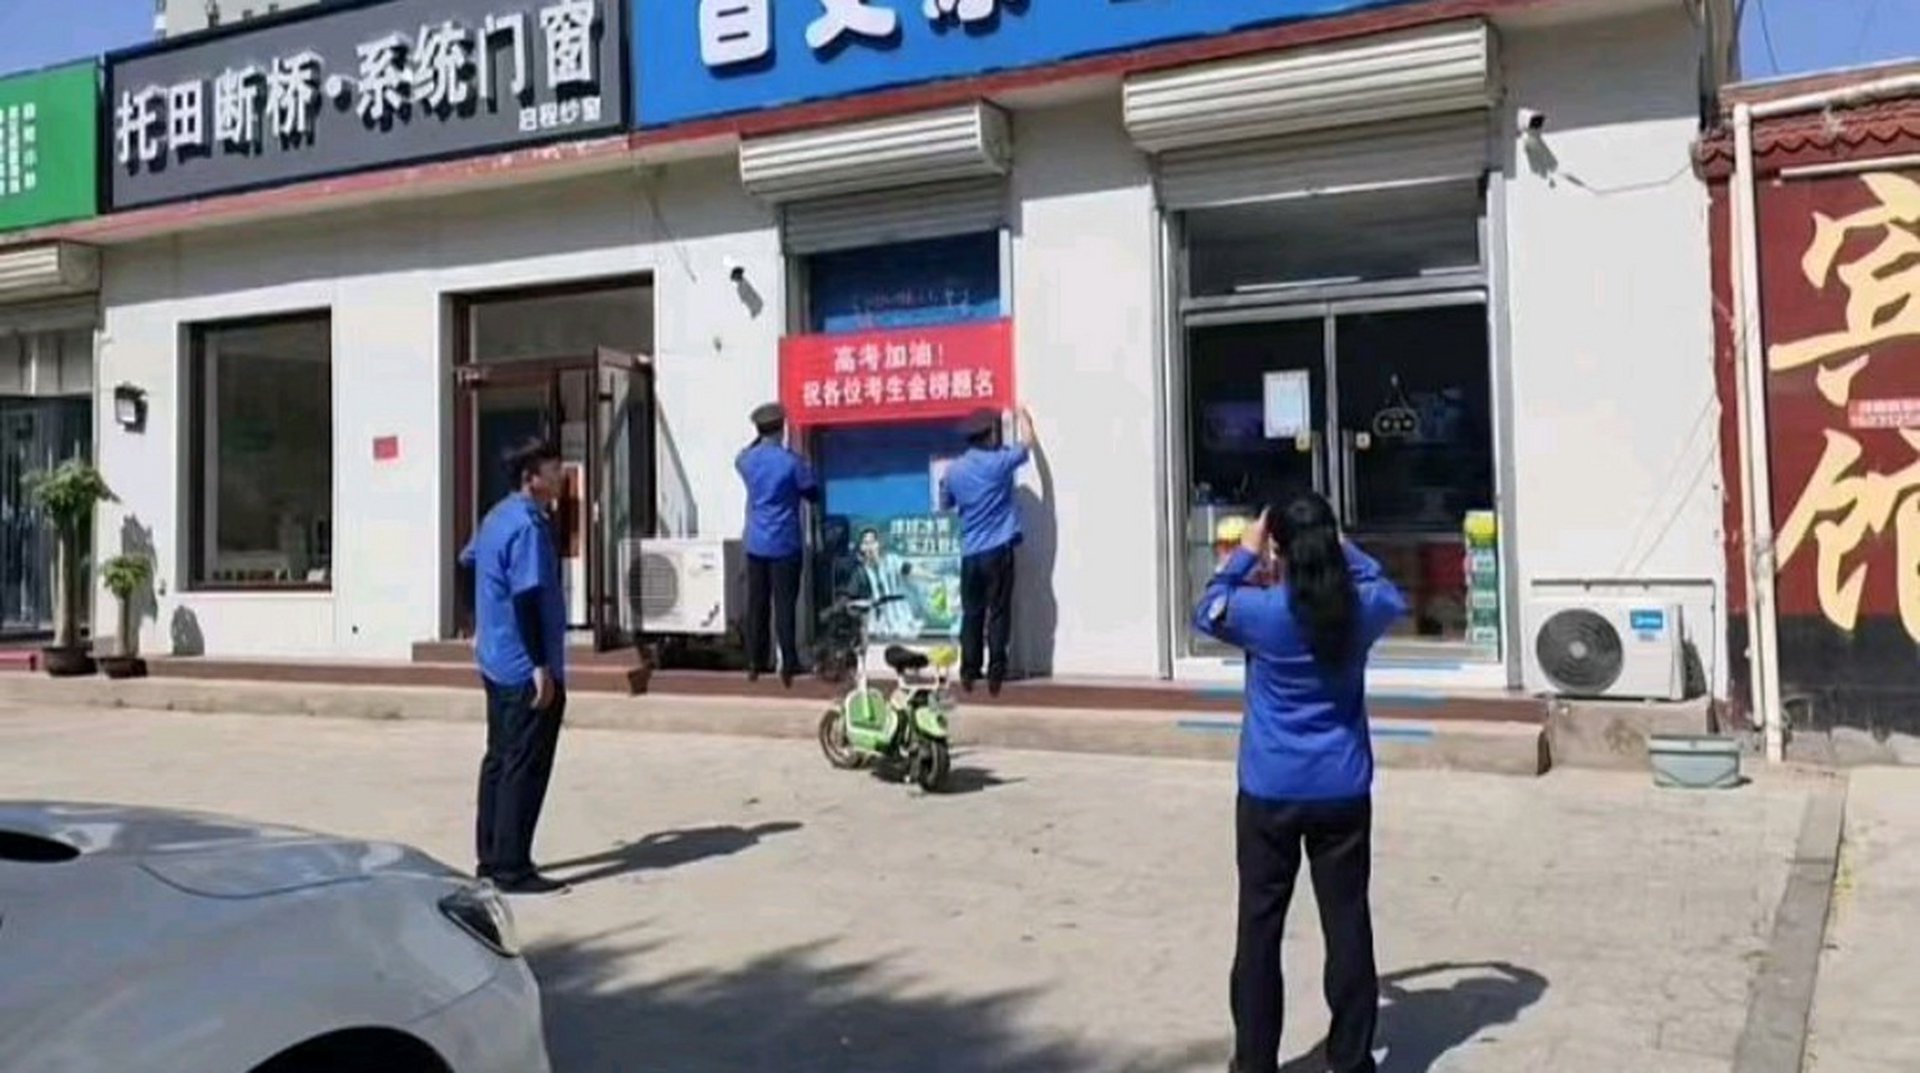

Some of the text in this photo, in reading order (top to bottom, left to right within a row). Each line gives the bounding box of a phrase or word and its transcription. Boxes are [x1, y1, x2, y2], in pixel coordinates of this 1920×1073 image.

[803, 367, 995, 408] 祝各位考生金榜题名
